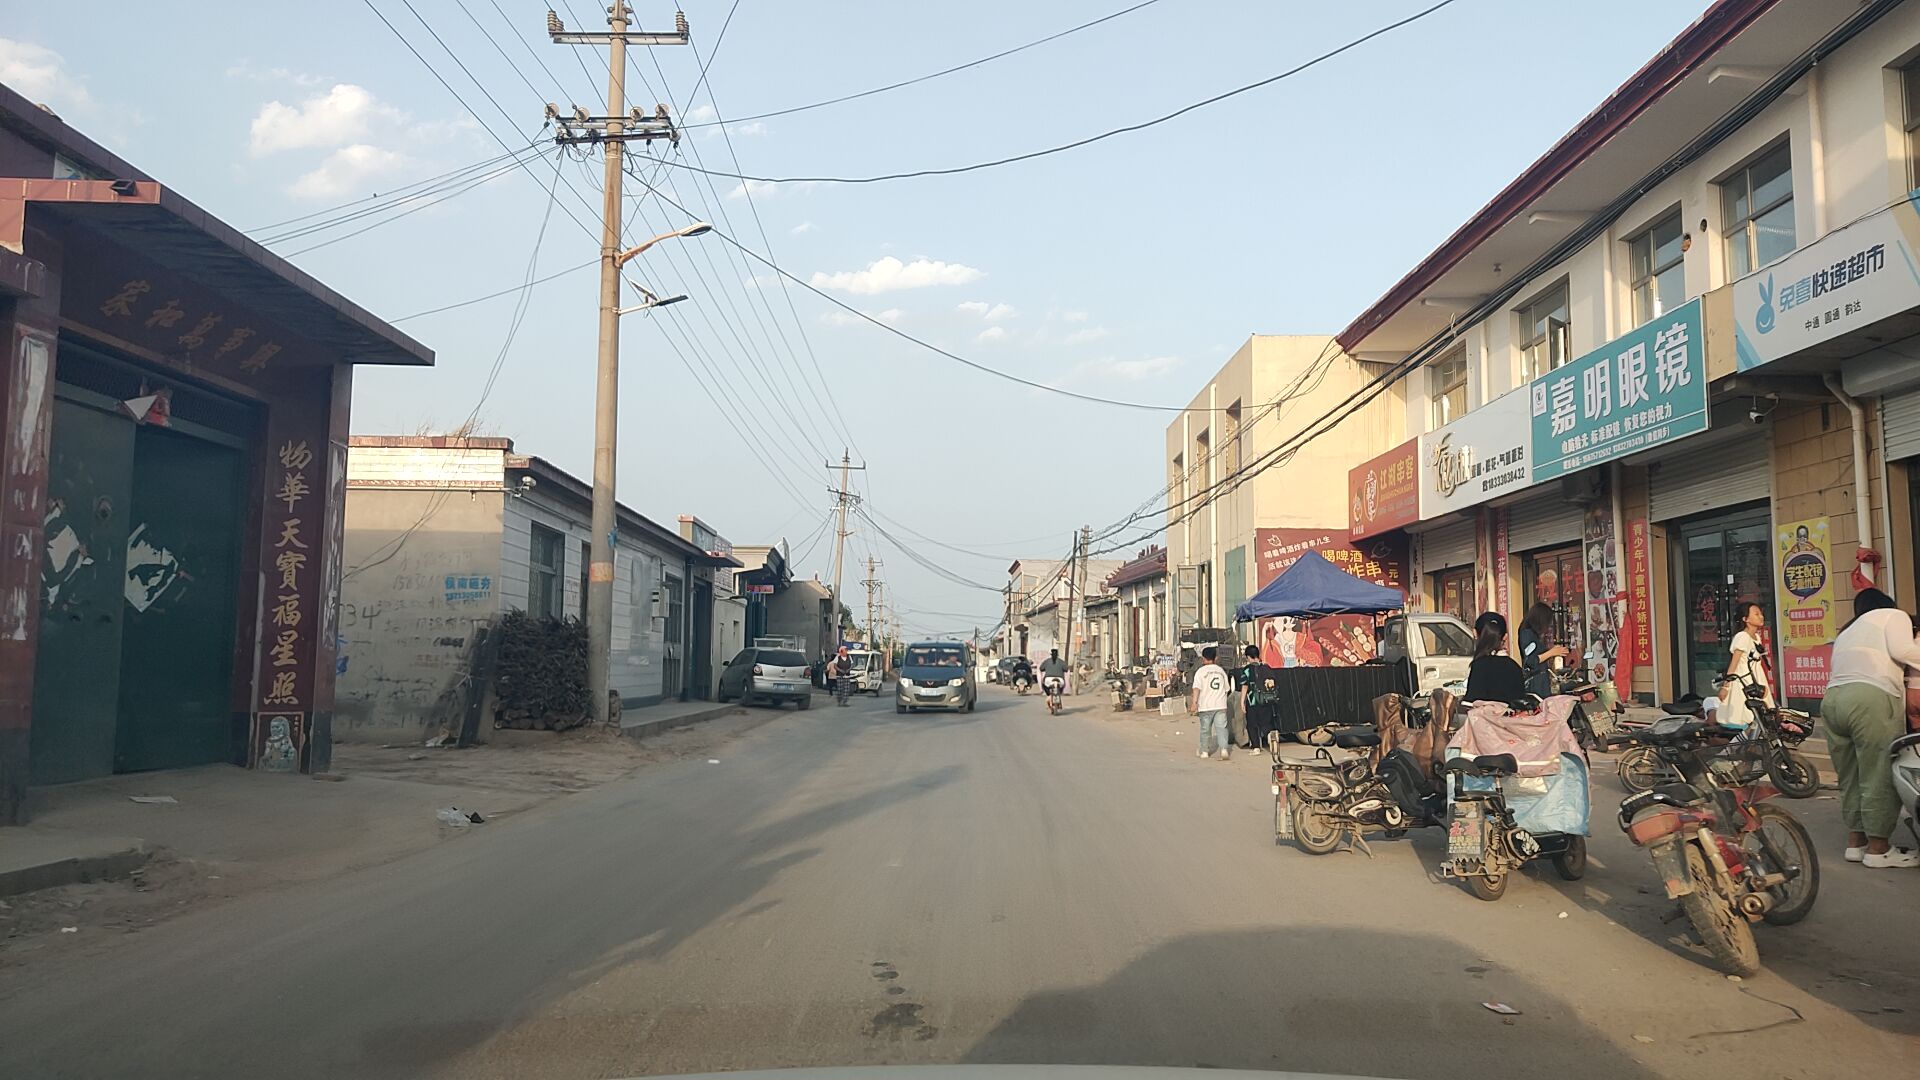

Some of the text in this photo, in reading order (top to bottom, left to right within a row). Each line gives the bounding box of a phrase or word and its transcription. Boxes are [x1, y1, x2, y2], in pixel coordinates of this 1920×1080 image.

[1804, 300, 1861, 332] 中通 圆通 韵达
[1551, 322, 1692, 438] 嘉明眼镜
[1624, 402, 1672, 432] 恢复您的视力
[1321, 549, 1363, 563] 喝啤酒
[263, 439, 313, 706] 物華天寶福星照
[1341, 561, 1382, 578] 炸串
[1786, 563, 1823, 579] 学生配镜
[1632, 523, 1649, 661] 青少年儿童视力矫正中心
[1789, 623, 1825, 639] 嘉明眼镜
[1210, 677, 1219, 689] G
